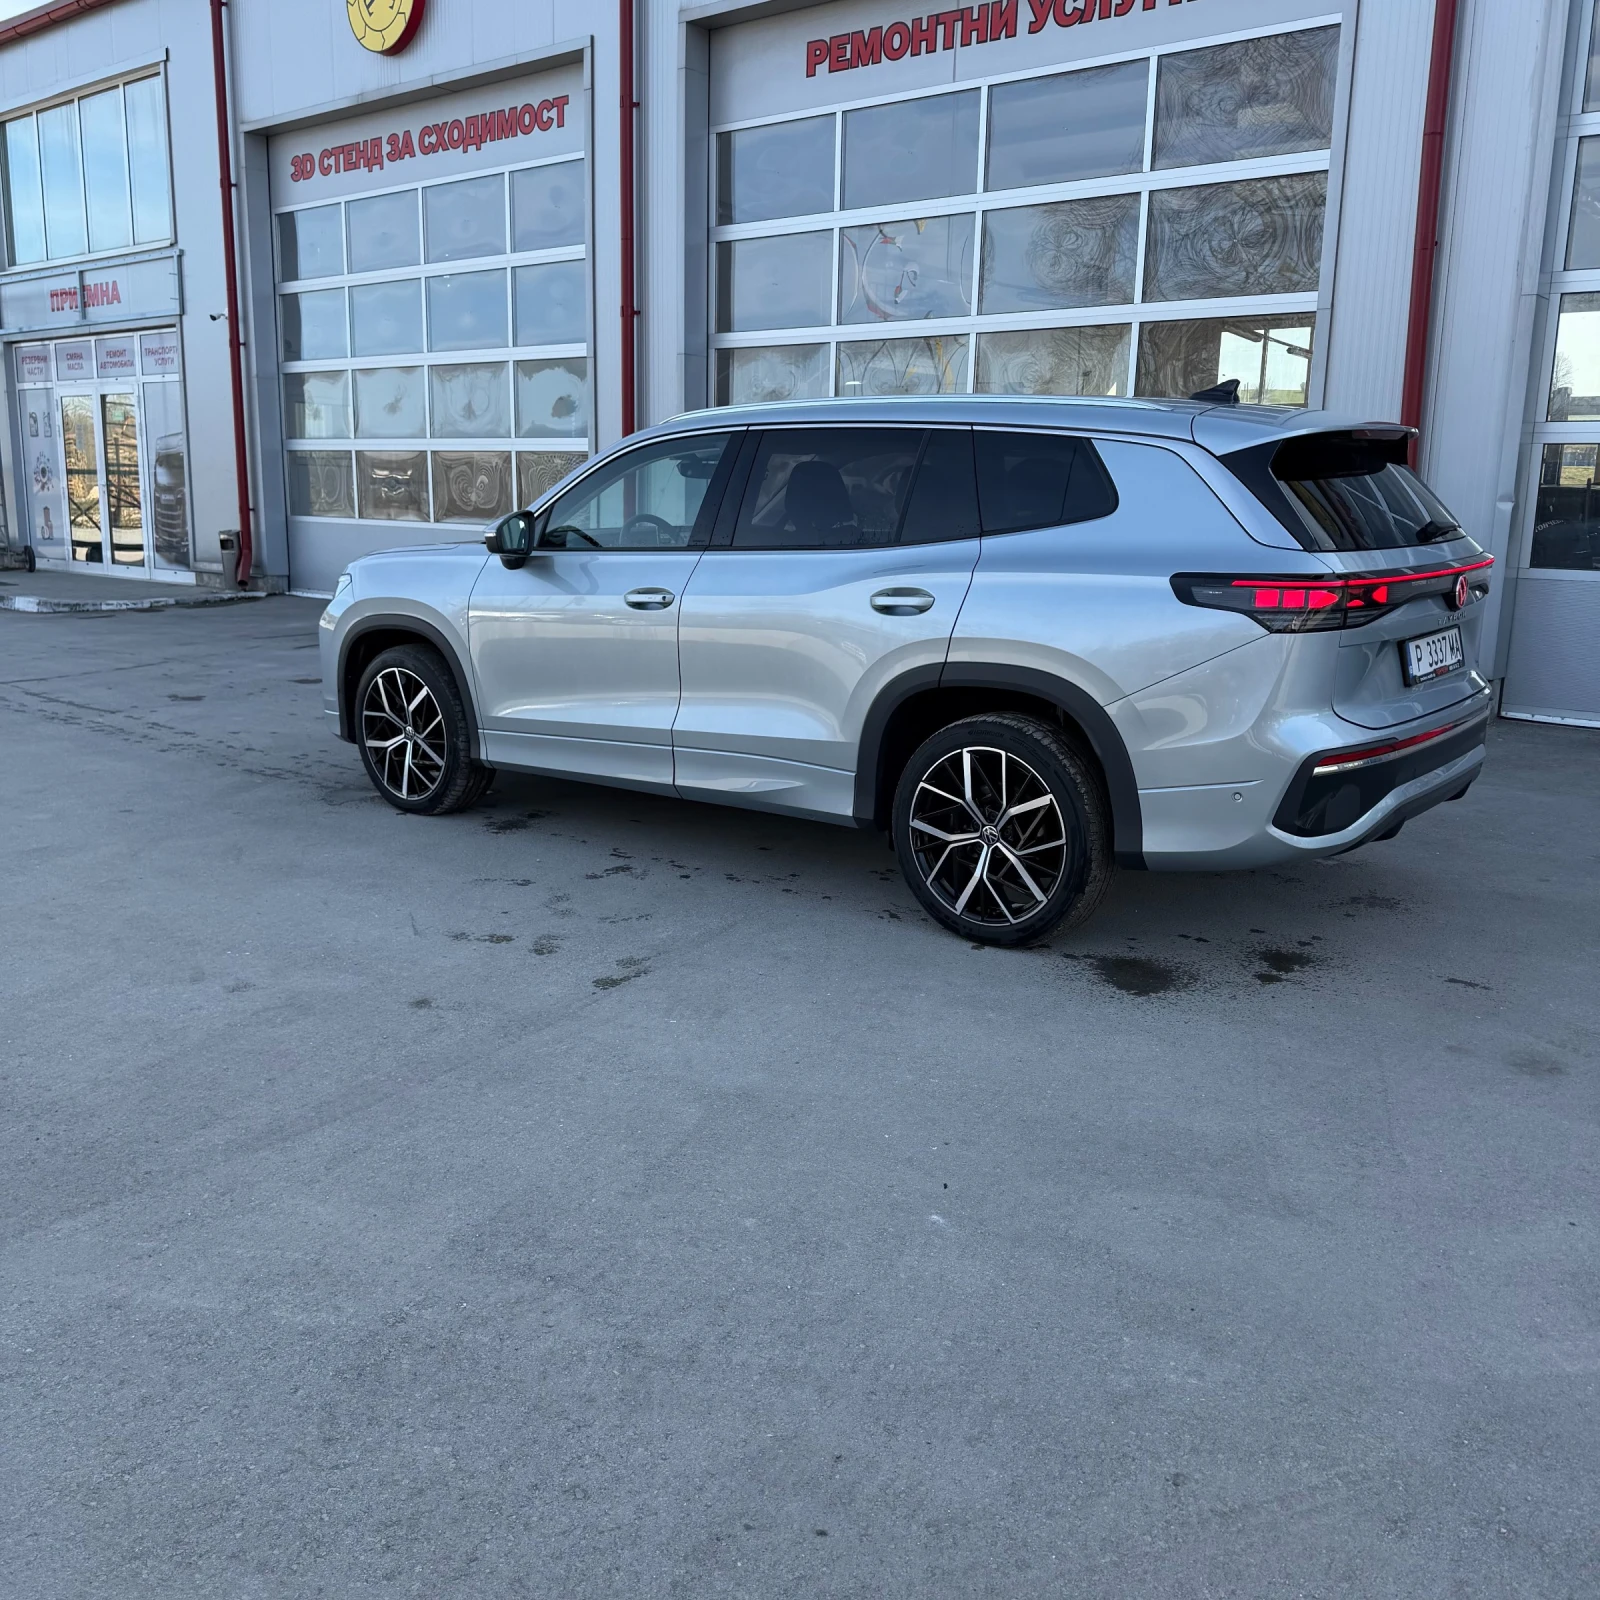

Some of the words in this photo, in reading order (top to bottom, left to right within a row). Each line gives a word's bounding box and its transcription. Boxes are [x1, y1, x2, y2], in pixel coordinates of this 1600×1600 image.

[806, 0, 1019, 78] РЕМОНТНИ
[318, 136, 384, 176] СТЕНД
[387, 130, 416, 162] ЗА
[418, 95, 569, 154] СХОДИМОСТ
[65, 352, 83, 361] СМЯНА
[105, 349, 126, 359] РЕМОНТ
[154, 357, 174, 366] УСЛУГИ
[26, 366, 44, 376] ЧАСТИ
[1415, 644, 1423, 672] P
[1426, 636, 1447, 668] 3337
[1448, 632, 1462, 661] MA
